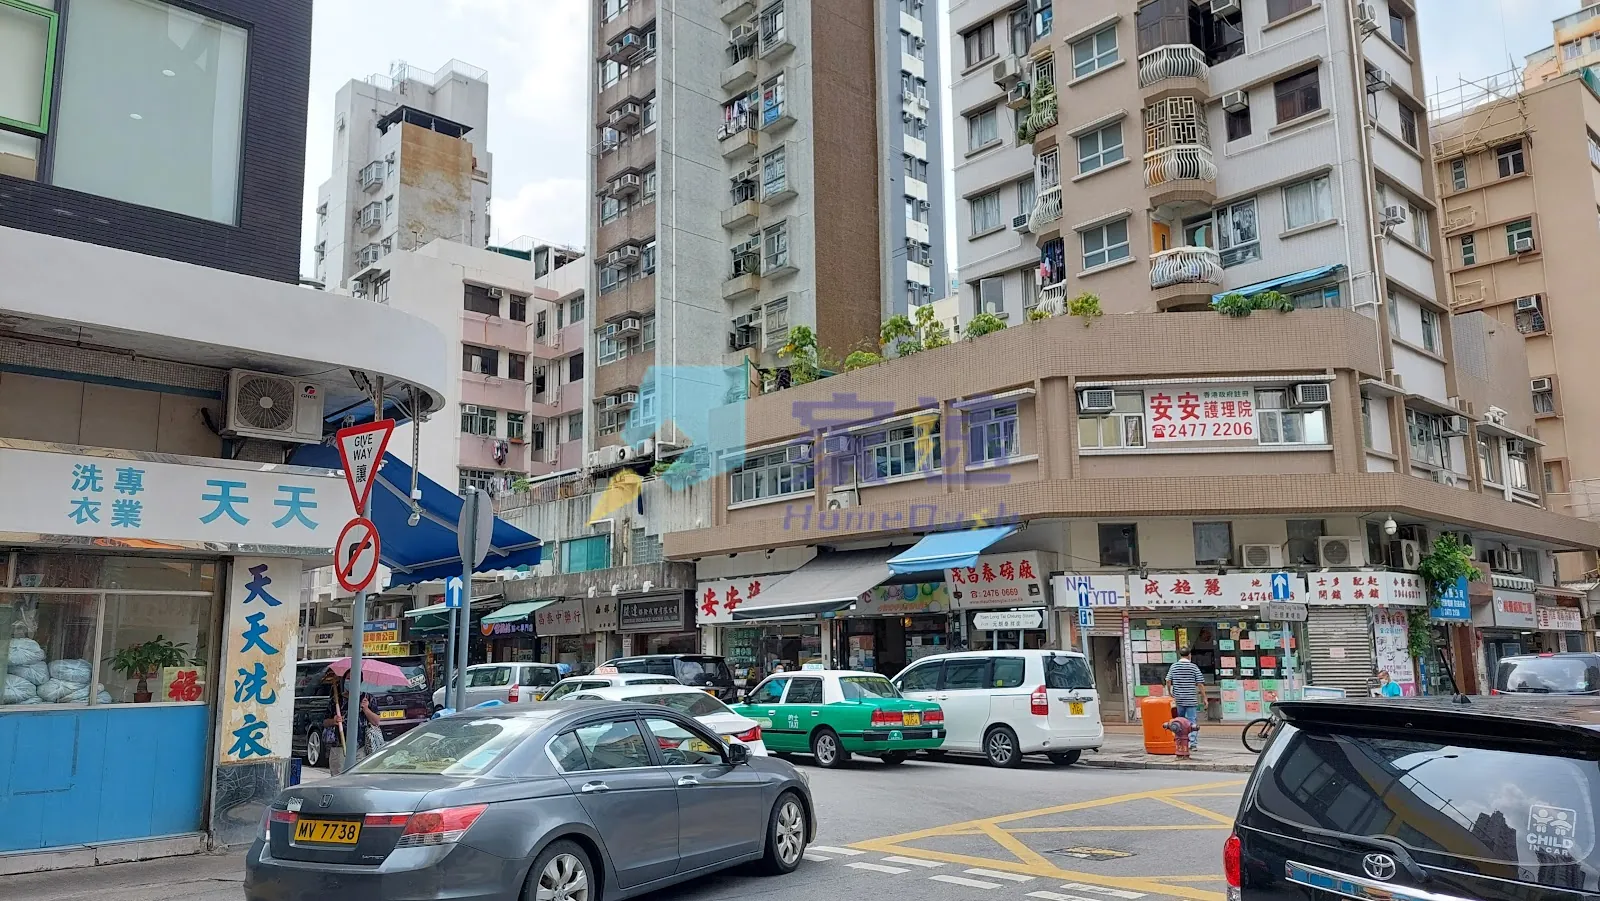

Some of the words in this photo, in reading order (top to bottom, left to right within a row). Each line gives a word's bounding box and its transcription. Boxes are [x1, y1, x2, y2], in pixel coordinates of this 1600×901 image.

[1168, 423, 1206, 438] 2477
[1213, 421, 1253, 436] 2206
[354, 433, 373, 447] GIVE
[353, 447, 373, 461] WAY
[355, 464, 367, 483] 讓
[198, 478, 319, 531] 天天
[983, 589, 999, 598] 2476
[1240, 591, 1295, 602] 247468
[228, 563, 283, 760] 天天洗衣
[168, 670, 202, 702] 福
[298, 822, 315, 839] MV
[320, 823, 356, 840] 7738
[1526, 833, 1574, 849] CHILD
[1545, 846, 1569, 856] CAR
